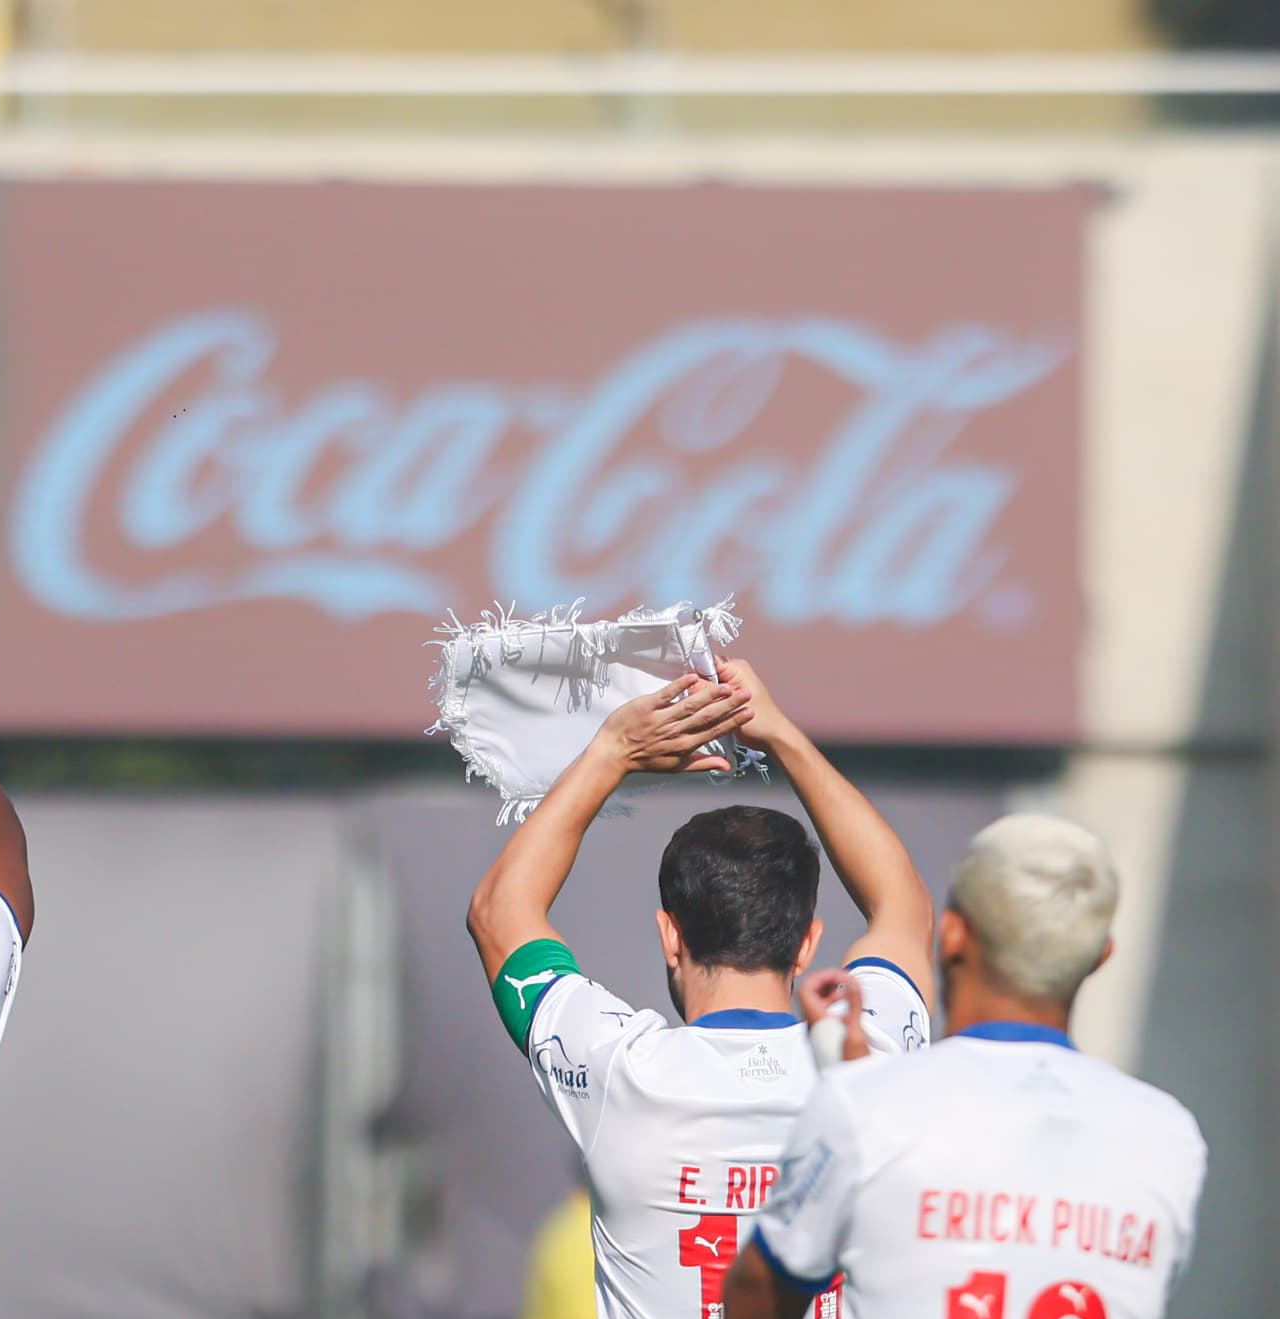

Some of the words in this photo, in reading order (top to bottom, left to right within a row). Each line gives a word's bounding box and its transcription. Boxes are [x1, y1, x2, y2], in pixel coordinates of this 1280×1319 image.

[8, 308, 1072, 630] Coca-Cola
[679, 1166, 706, 1206] E.
[916, 1188, 1039, 1245] ERICK
[1051, 1199, 1159, 1269] PULGA
